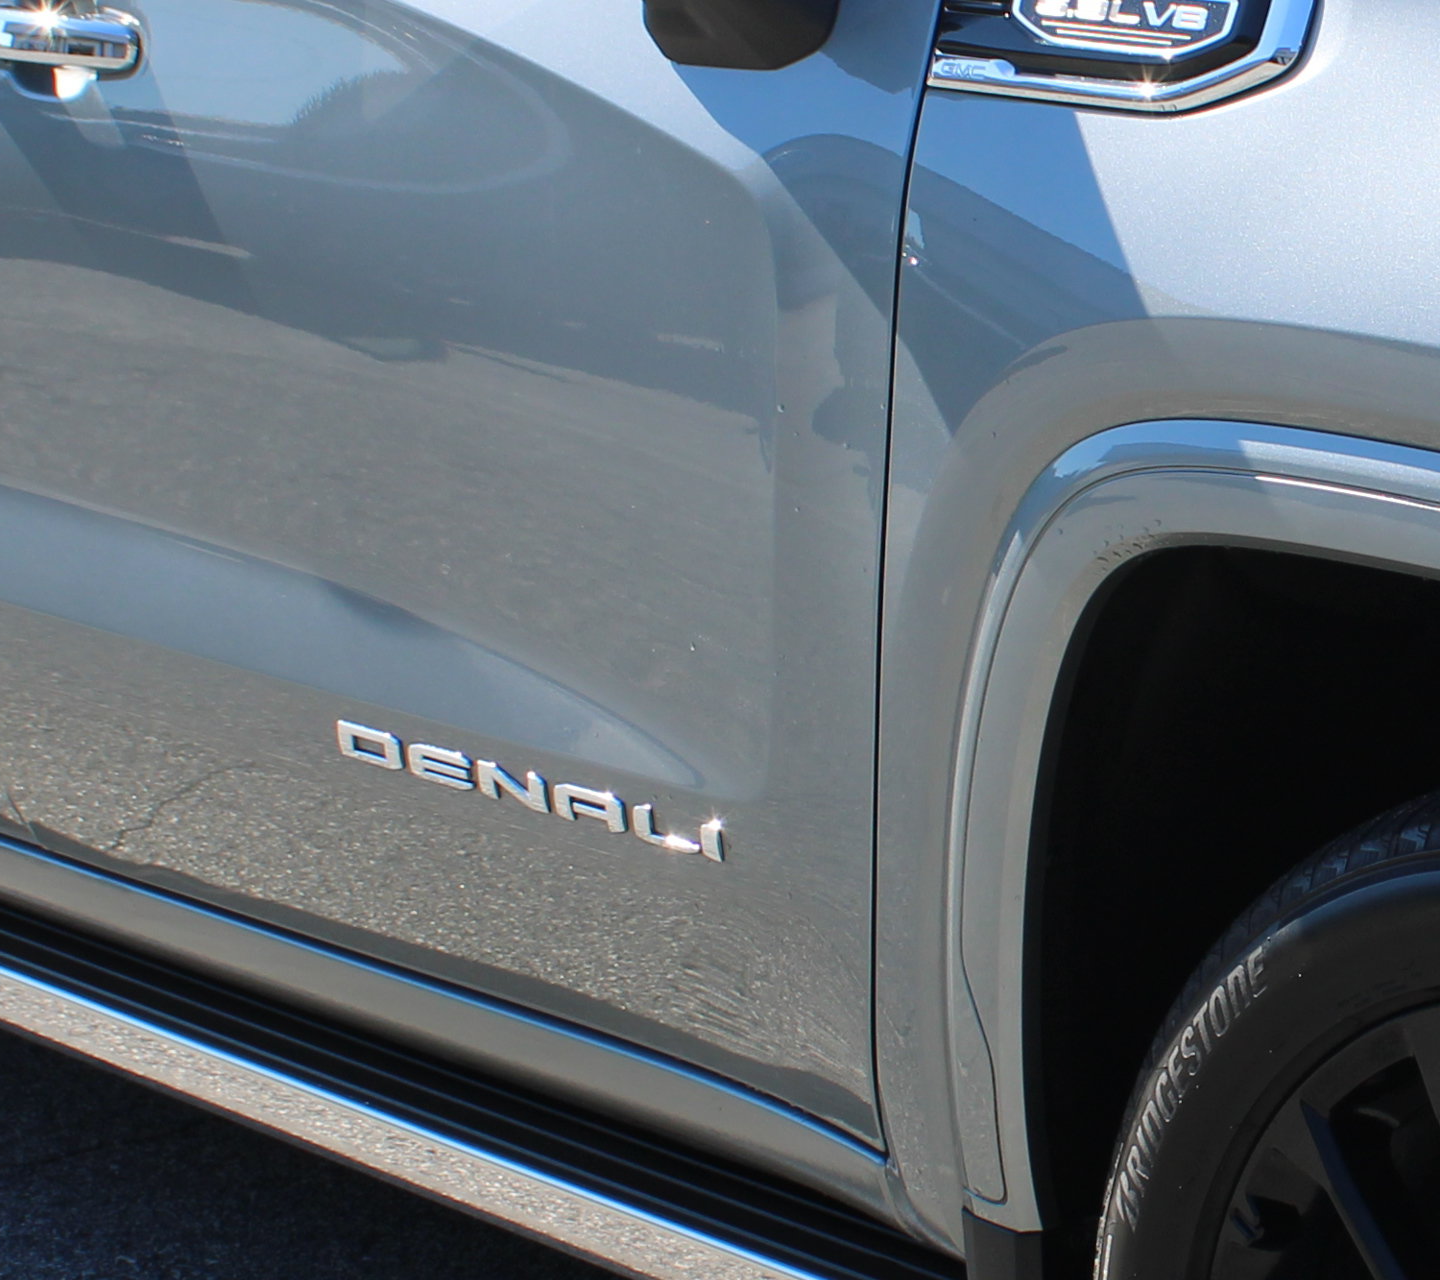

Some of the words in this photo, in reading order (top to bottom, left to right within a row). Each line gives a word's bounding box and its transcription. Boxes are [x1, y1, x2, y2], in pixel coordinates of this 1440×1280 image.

[1142, 0, 1209, 30] V8
[940, 60, 986, 79] GMC
[336, 719, 726, 863] DENALI
[1115, 944, 1268, 1234] BRIDGESTONE
